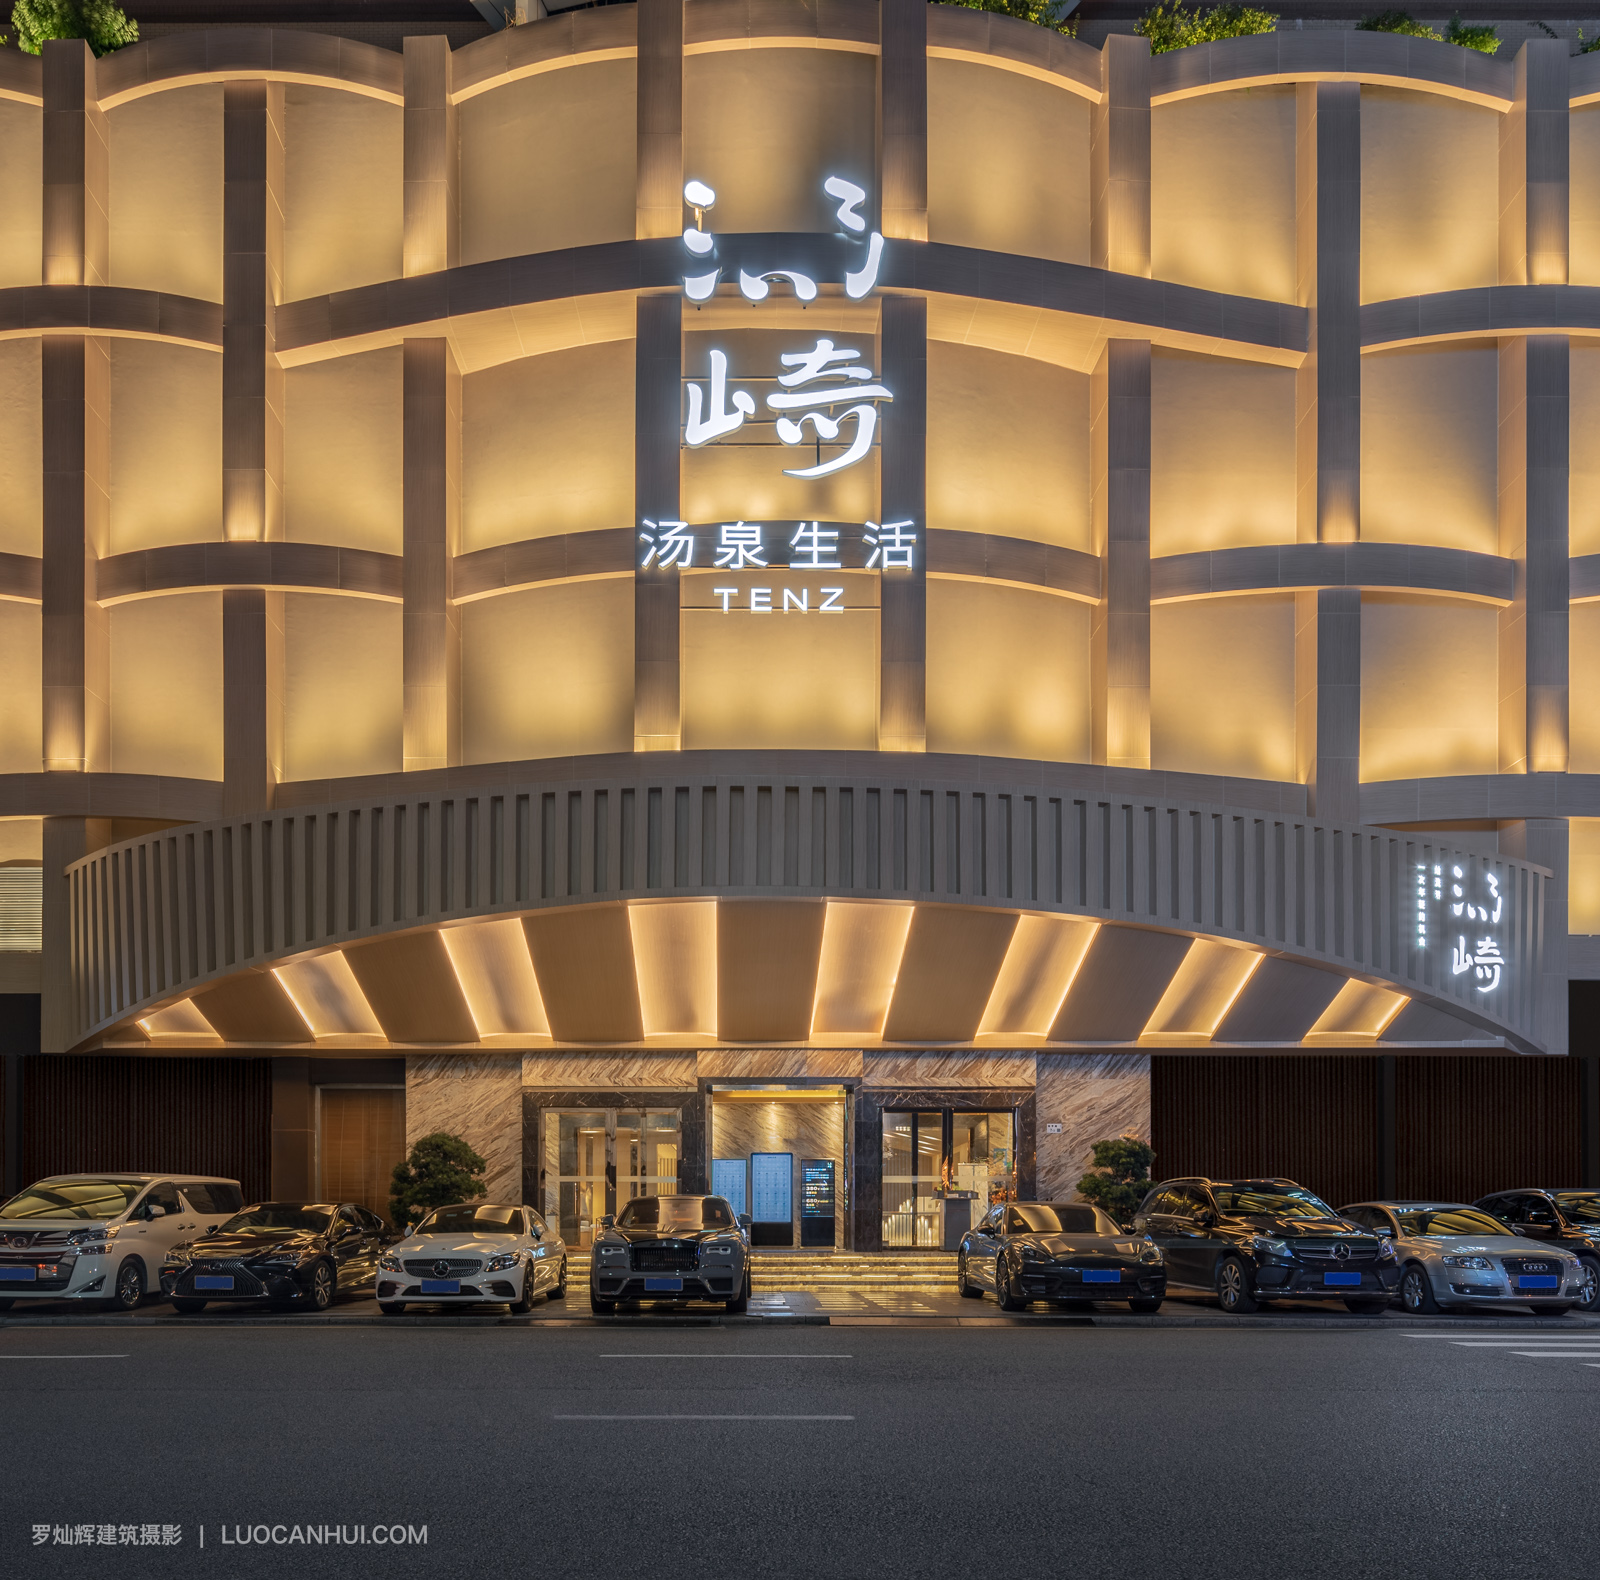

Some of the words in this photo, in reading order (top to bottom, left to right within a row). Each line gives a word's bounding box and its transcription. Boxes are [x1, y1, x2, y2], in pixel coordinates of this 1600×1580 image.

[639, 518, 917, 571] 汤泉生活
[713, 587, 845, 614] TENZ
